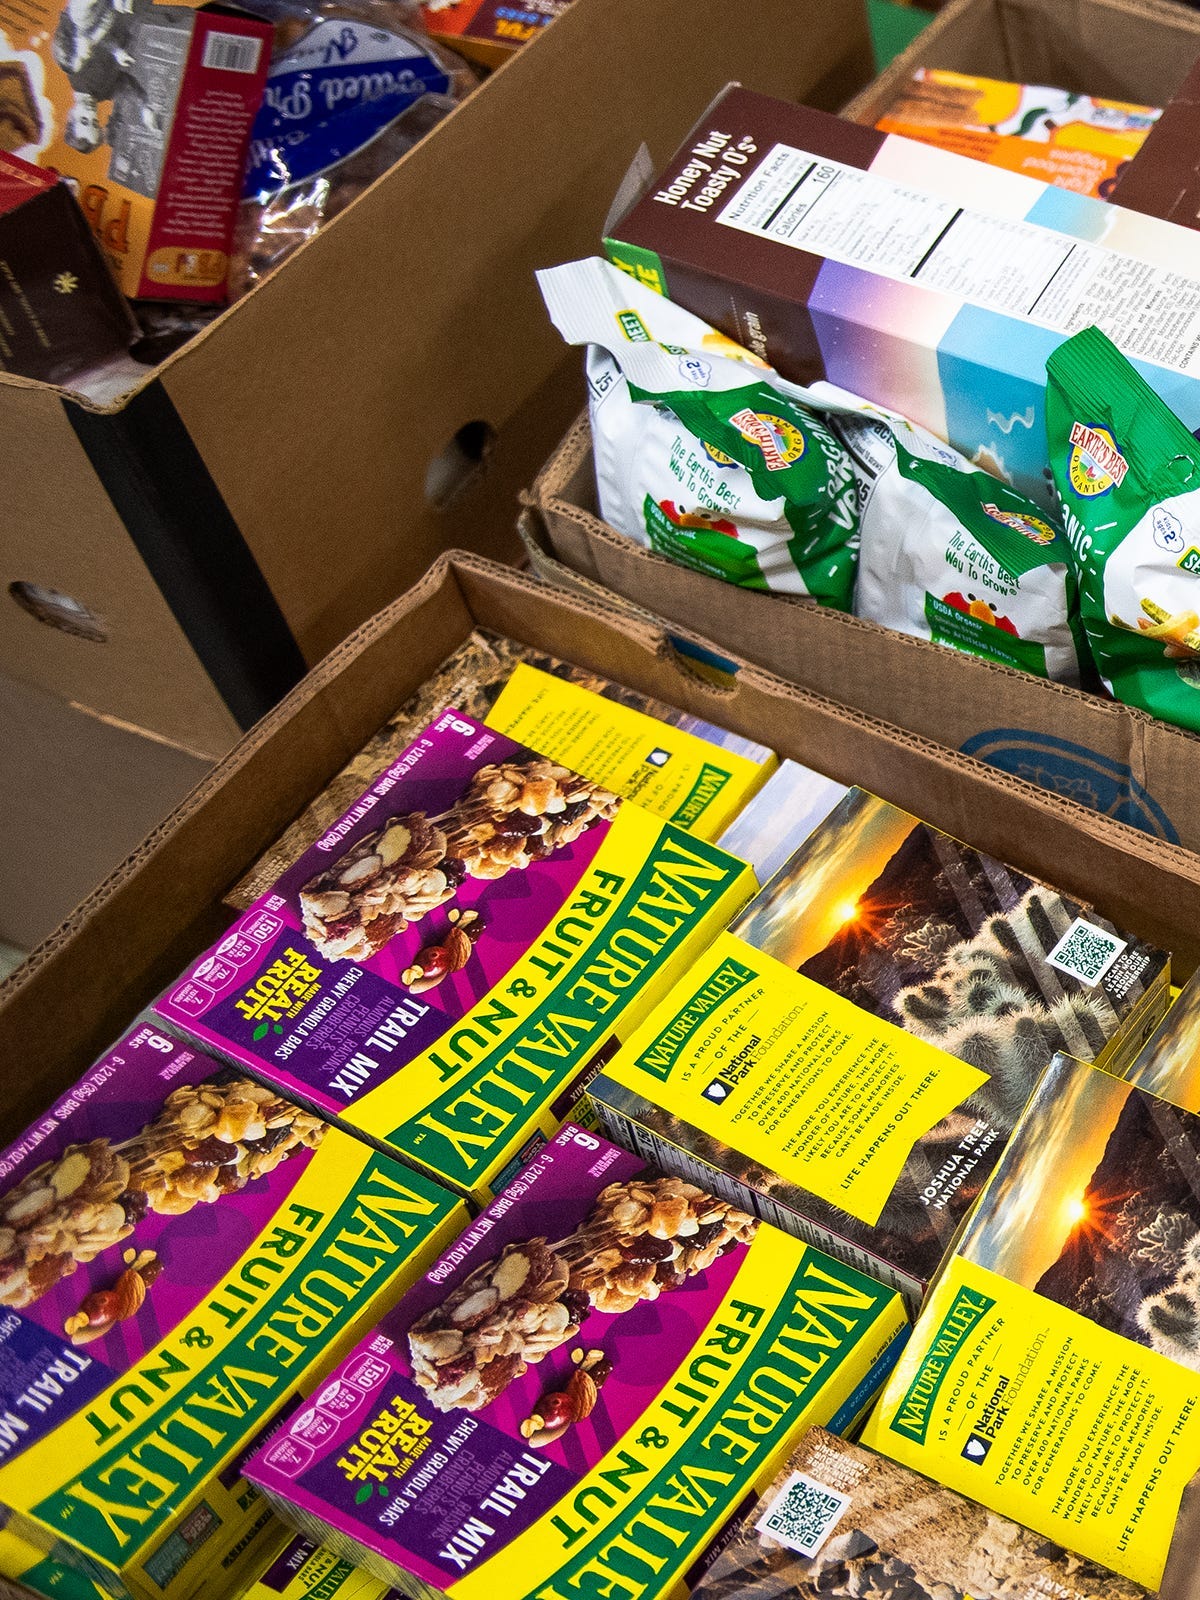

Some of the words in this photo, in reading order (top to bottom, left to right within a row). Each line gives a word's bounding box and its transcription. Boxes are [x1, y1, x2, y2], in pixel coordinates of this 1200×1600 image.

[653, 157, 712, 208] Honey
[691, 130, 732, 158] Nut
[680, 164, 741, 212] Toasty
[728, 180, 767, 220] Nutrition
[762, 152, 790, 177] Facts
[774, 203, 807, 236] Calories
[812, 165, 835, 183] 160
[1178, 341, 1200, 369] CONTAINS
[669, 454, 685, 482] Way
[687, 473, 695, 492] To
[671, 435, 686, 459] The
[686, 453, 715, 489] Earth's
[716, 482, 741, 509] Best
[1071, 424, 1108, 463] EARTH'S
[1104, 450, 1129, 484] BEST
[1072, 455, 1105, 493] ORGANIC
[945, 548, 963, 573] Way
[968, 562, 978, 580] To
[949, 530, 965, 551] The
[964, 542, 995, 574] Earth's
[997, 567, 1021, 589] Best
[933, 601, 953, 617] USDA
[433, 712, 456, 733] BARS
[448, 717, 477, 738] 6
[528, 869, 626, 981] FRUIT
[565, 837, 729, 1014] NATURE
[234, 947, 307, 1020] FRUIT
[250, 961, 323, 1021] REAL
[300, 982, 322, 1002] MADE
[330, 967, 363, 999] CHEWY
[505, 977, 537, 998] &
[1104, 963, 1122, 982] SCAN
[1118, 955, 1128, 965] TO
[1105, 970, 1124, 992] LEARN
[1122, 950, 1139, 970] MORE
[1114, 970, 1131, 993] ABOUT
[1129, 955, 1143, 971] OUR
[1116, 956, 1150, 999] PARTNERSHIP
[285, 1000, 305, 1019] WITH
[294, 996, 337, 1036] GRANOLA
[364, 998, 430, 1052] TRAIL
[642, 1011, 699, 1074] NATURE
[688, 964, 747, 1013] VALLEY
[681, 1071, 691, 1081] IS
[693, 1026, 722, 1059] PROUD
[721, 988, 765, 1025] PARTNER
[274, 1034, 302, 1060] BARS
[427, 998, 517, 1083] NUT
[714, 1044, 727, 1059] OF
[727, 1024, 747, 1043] THE
[718, 1034, 761, 1079] National
[728, 1059, 757, 1085] Park
[749, 1005, 804, 1061] Foundation
[730, 1085, 766, 1124] TOGETHER
[763, 1073, 776, 1084] WE
[774, 1048, 797, 1073] SHARE
[801, 1011, 828, 1042] MISSION
[328, 1052, 379, 1098] MIX
[414, 1012, 597, 1170] VALLEY
[757, 1105, 777, 1126] OVER
[776, 1090, 790, 1105] 400
[788, 1054, 822, 1090] NATIONAL
[819, 1030, 841, 1053] PARKS
[553, 1125, 579, 1147] BARS
[570, 1130, 602, 1152] 6
[840, 1167, 861, 1189] LIFE
[857, 1123, 896, 1167] HAPPENS
[894, 1101, 912, 1122] OUT
[910, 1069, 940, 1100] THERE.
[920, 1150, 965, 1206] JOSHUA
[958, 1119, 990, 1157] TREE
[933, 1154, 980, 1210] NATIONAL
[973, 1128, 1000, 1160] PARK
[208, 1203, 324, 1329] FRUIT
[245, 1167, 439, 1368] NATURE
[179, 1326, 214, 1349] &
[660, 1299, 766, 1428] FRUIT
[700, 1262, 877, 1465] NATURE
[897, 1357, 945, 1435] NATURE
[931, 1293, 985, 1357] VALLEY
[85, 1349, 190, 1446] NUT
[973, 1374, 1010, 1433] National
[984, 1405, 1010, 1439] Park
[1000, 1333, 1047, 1406] Foundation
[64, 1365, 279, 1547] VALLEY
[336, 1395, 416, 1481] FRUIT
[357, 1411, 433, 1482] REAL
[442, 1417, 478, 1455] CHEWY
[635, 1426, 669, 1449] &
[402, 1452, 448, 1499] GRANOLA
[479, 1452, 552, 1516] TRAIL
[550, 1450, 649, 1549] NUT
[1116, 1525, 1134, 1552] LIFE
[1130, 1467, 1162, 1523] HAPPENS
[1158, 1438, 1175, 1465] OUT
[1171, 1396, 1198, 1436] THERE.
[379, 1496, 410, 1526] BARS
[720, 1518, 742, 1546] TRAIL
[439, 1516, 495, 1569] MIX
[705, 1545, 722, 1568] MIX
